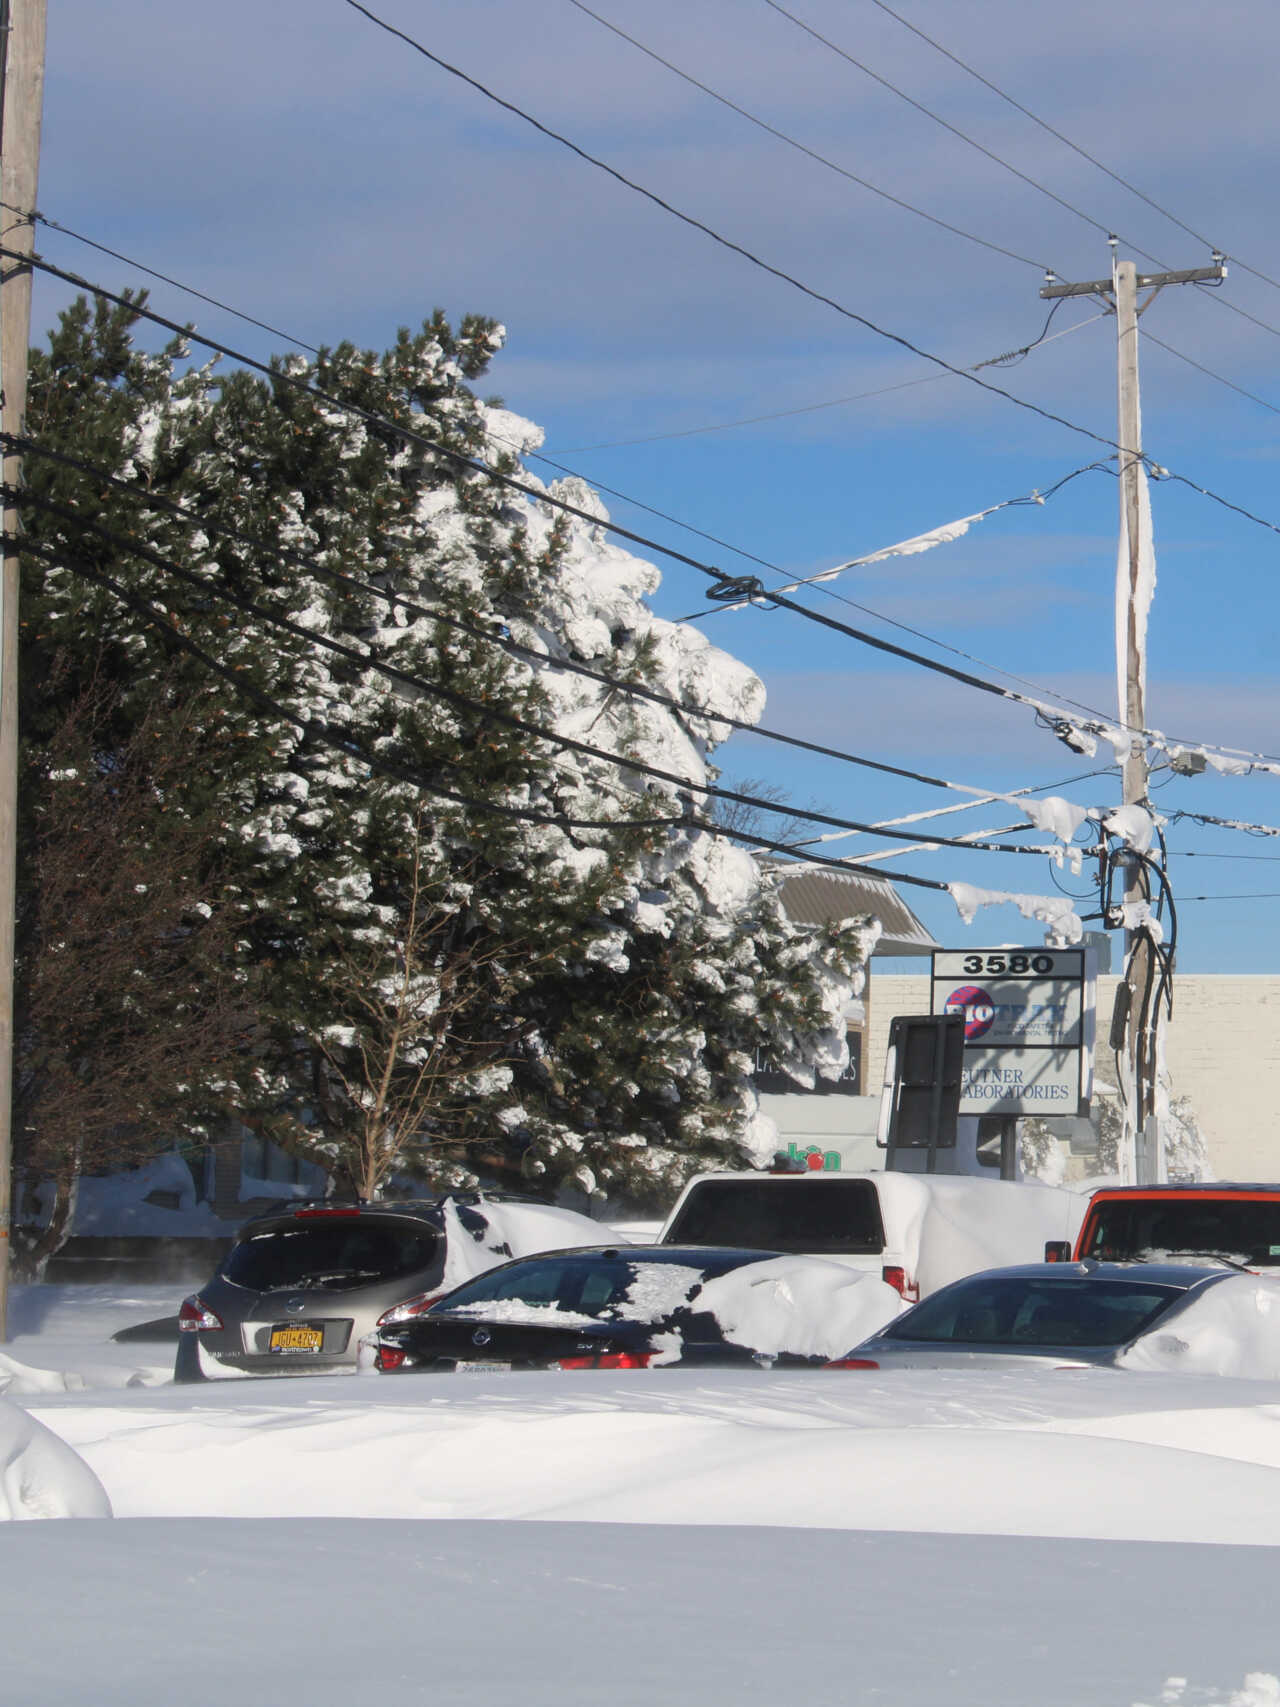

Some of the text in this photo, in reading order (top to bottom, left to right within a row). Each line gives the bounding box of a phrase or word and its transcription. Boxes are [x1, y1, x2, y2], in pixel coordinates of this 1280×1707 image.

[963, 955, 1054, 974] 3580
[961, 1069, 1024, 1083] EUTNER
[961, 1085, 1069, 1099] ABORATORIES
